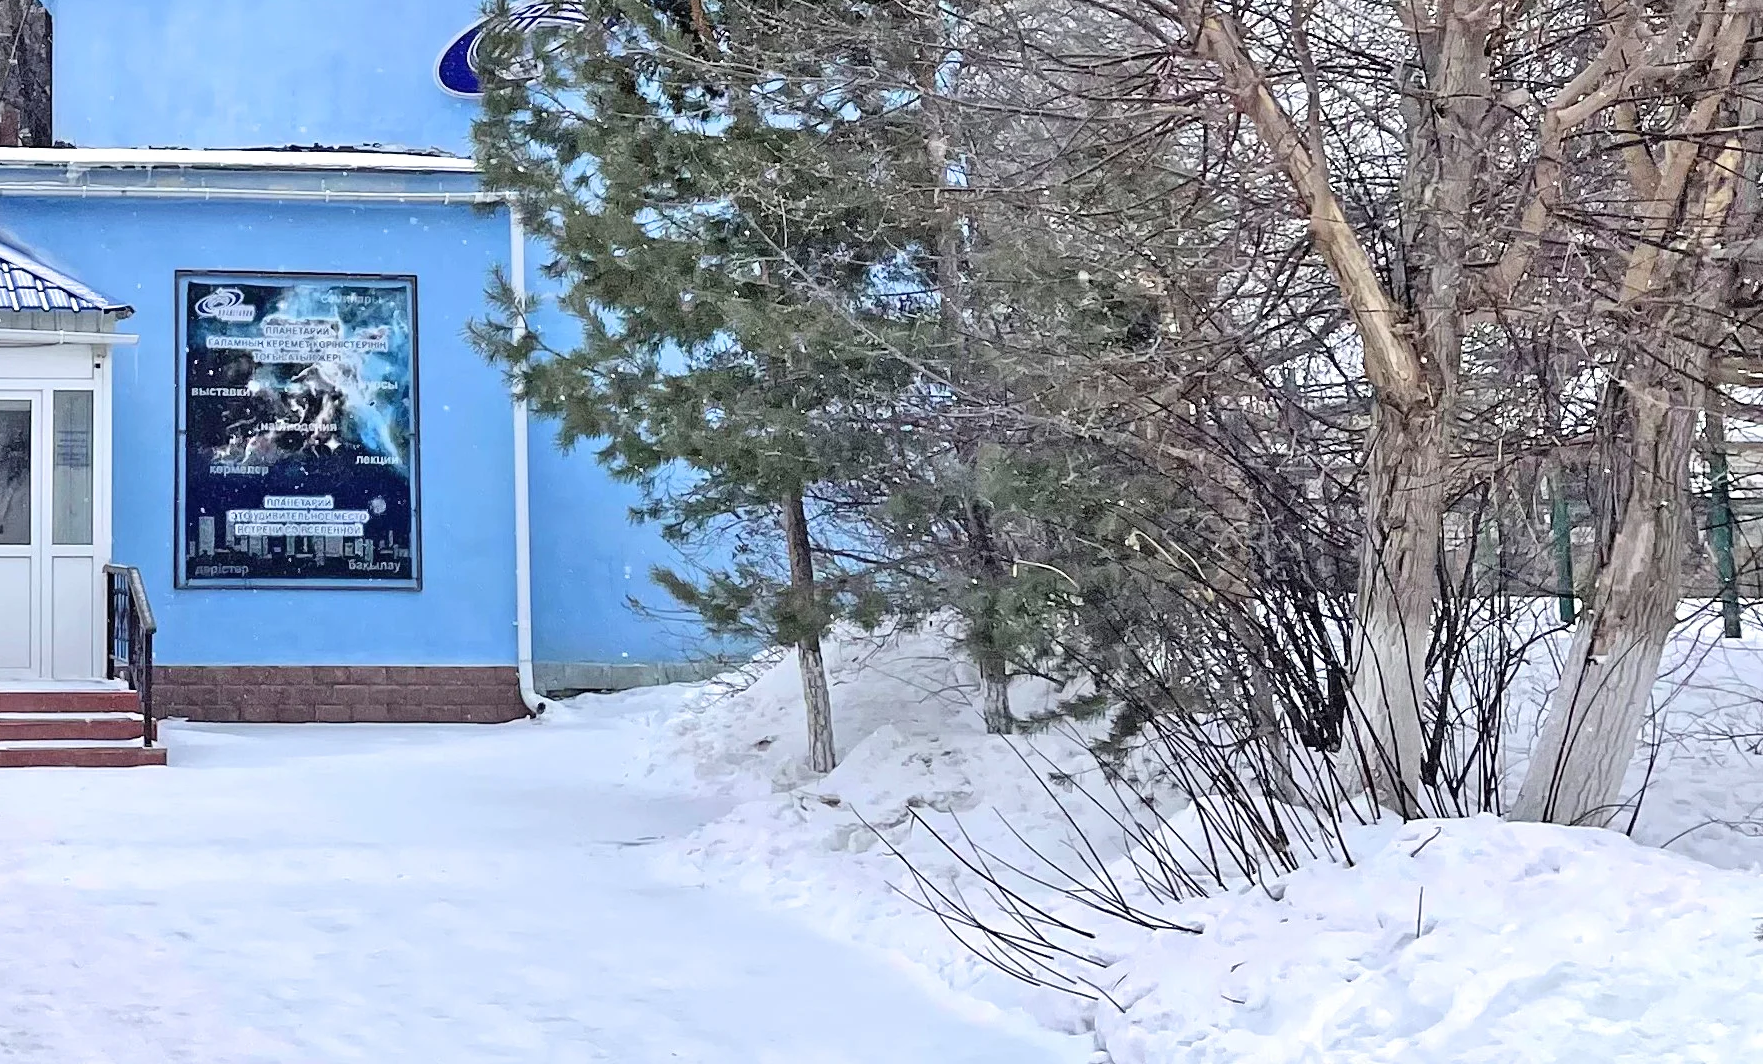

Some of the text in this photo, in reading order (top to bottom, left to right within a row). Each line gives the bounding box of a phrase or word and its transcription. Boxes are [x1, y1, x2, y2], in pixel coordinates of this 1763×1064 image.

[265, 326, 330, 336] ПЛАНЕТАРИЙ
[191, 387, 250, 397] выставки
[355, 456, 400, 466] лекции
[253, 512, 331, 522] УДИВИТЕЛЬНОЕ
[333, 512, 367, 521] МЕСТО
